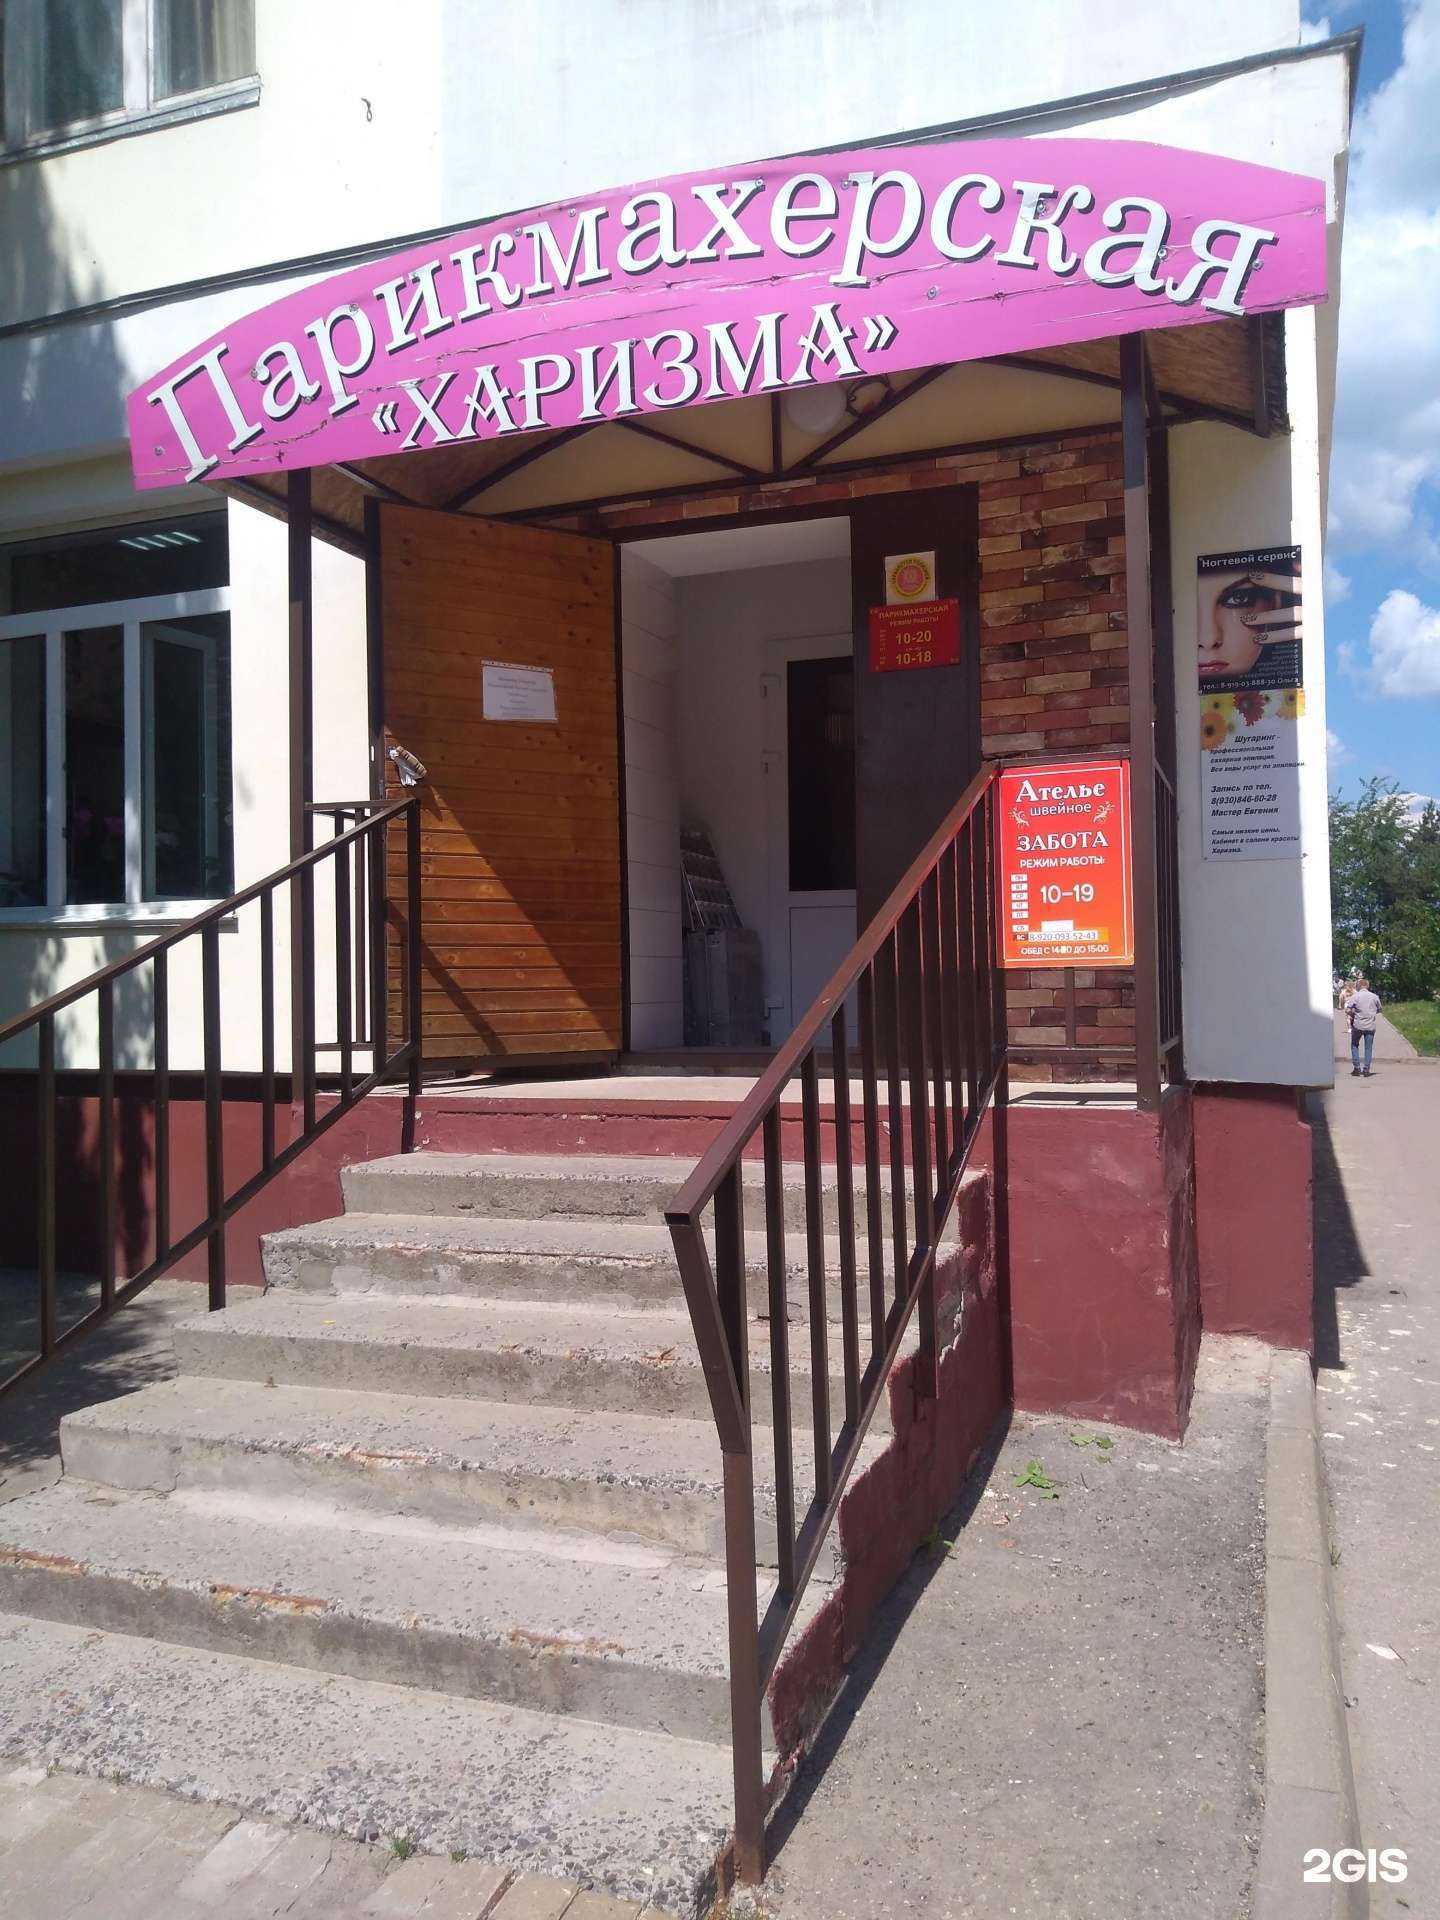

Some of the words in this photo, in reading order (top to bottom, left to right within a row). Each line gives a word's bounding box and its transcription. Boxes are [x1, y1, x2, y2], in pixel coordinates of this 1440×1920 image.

[147, 170, 1279, 484] Парикмахерская
[372, 302, 899, 449] «ХАРИЗМА»
[1202, 555, 1255, 568] Ногтевой
[1257, 550, 1297, 563] сервис
[896, 630, 932, 645] 10-20
[896, 650, 932, 665] 10-18
[1016, 780, 1106, 803] Ателье
[1210, 785, 1241, 793] Запись
[1030, 801, 1092, 817] швейное
[1211, 808, 1242, 817] Мастер
[1244, 806, 1279, 815] Евгения
[1016, 831, 1109, 852] ЗАБОТА
[1020, 857, 1058, 869] РЕЖИМ
[1040, 883, 1095, 904] 10-19
[1021, 947, 1042, 955] ОБЕД
[1074, 945, 1086, 954] ДО
